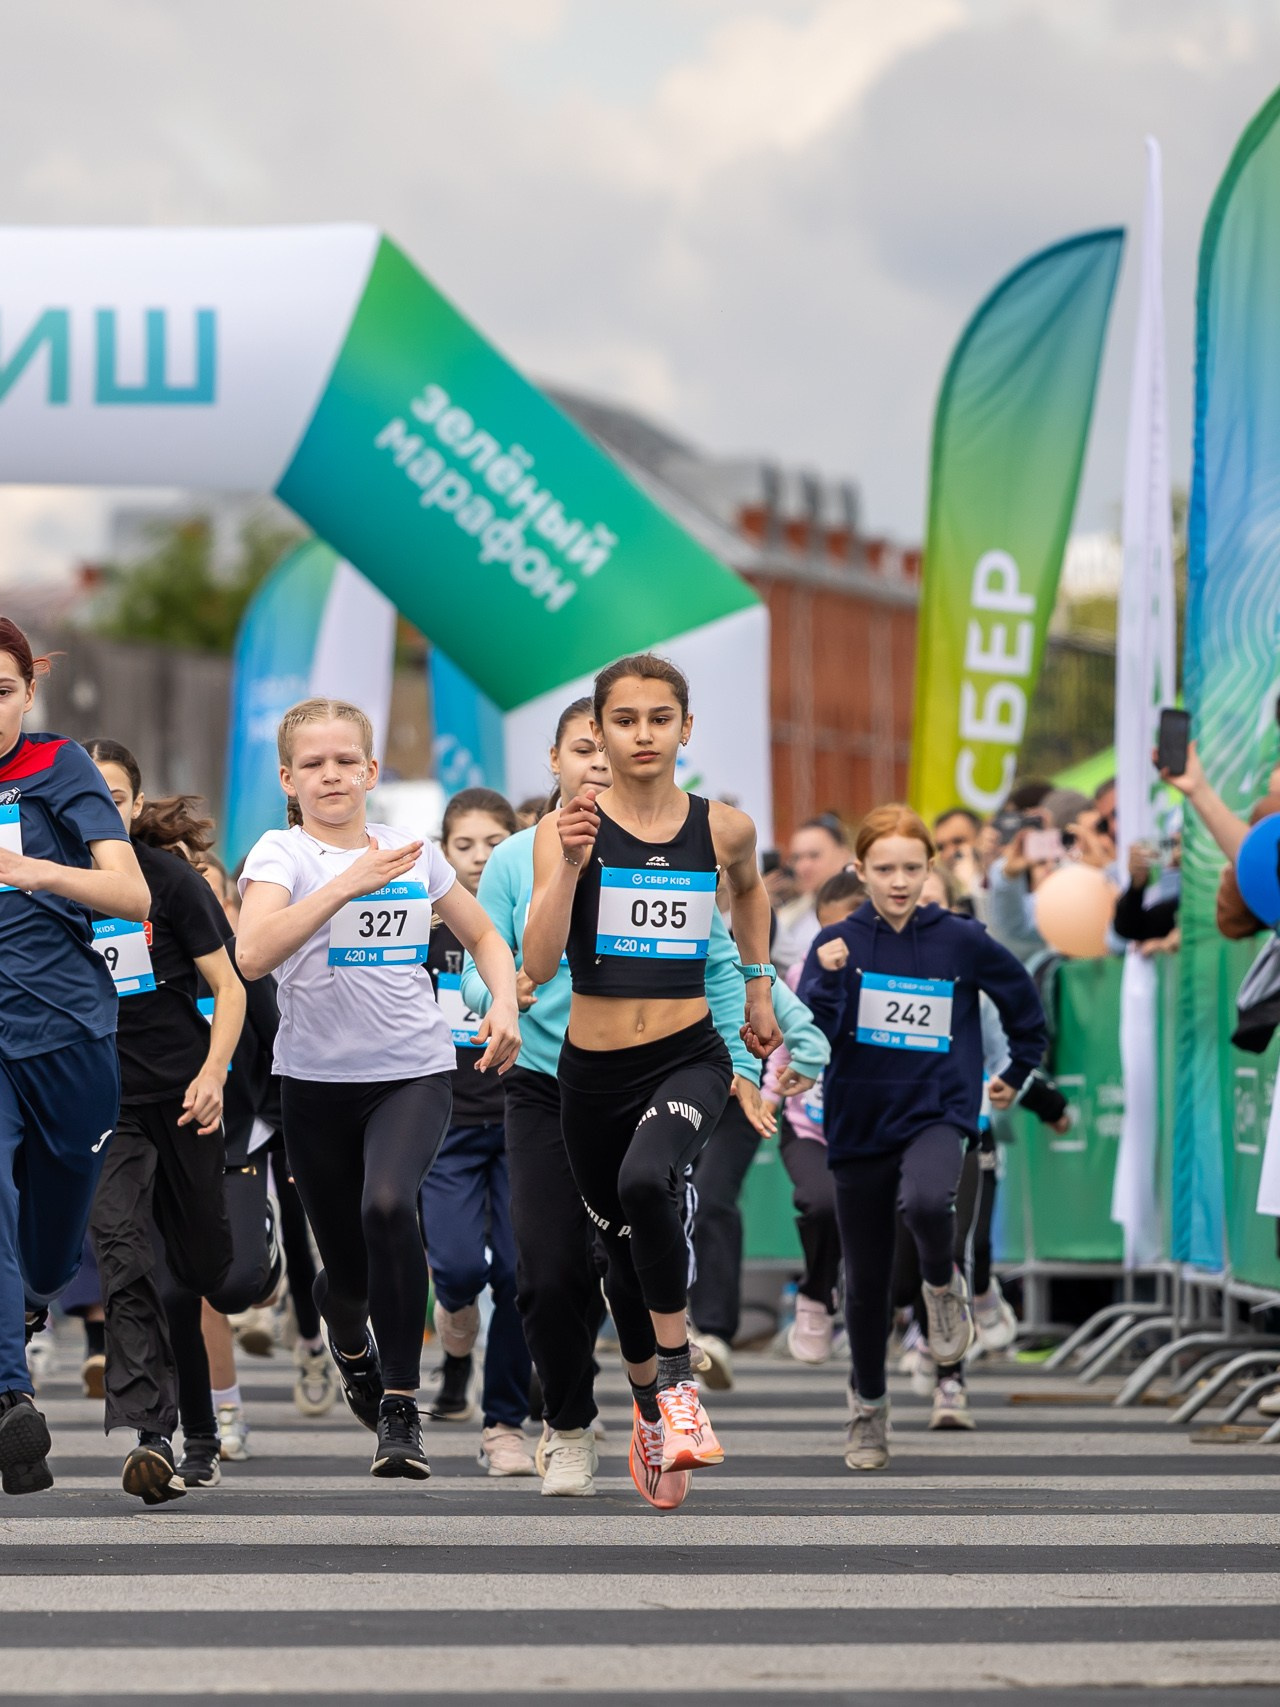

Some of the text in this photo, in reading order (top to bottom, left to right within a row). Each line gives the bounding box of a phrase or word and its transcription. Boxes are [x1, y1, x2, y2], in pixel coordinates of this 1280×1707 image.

[411, 382, 618, 577] зелёный
[374, 417, 577, 613] марафон
[955, 548, 1037, 813] СБЕР
[370, 886, 409, 896] БЕР KIDS
[644, 876, 691, 886] СБЕР KIDS
[358, 910, 408, 938] 327
[631, 899, 687, 929] 035
[96, 924, 116, 934] KIDS
[344, 950, 366, 962] 420
[614, 938, 638, 952] 420
[104, 946, 120, 971] 9
[885, 1001, 931, 1027] 242
[666, 1101, 703, 1131] PUMA
